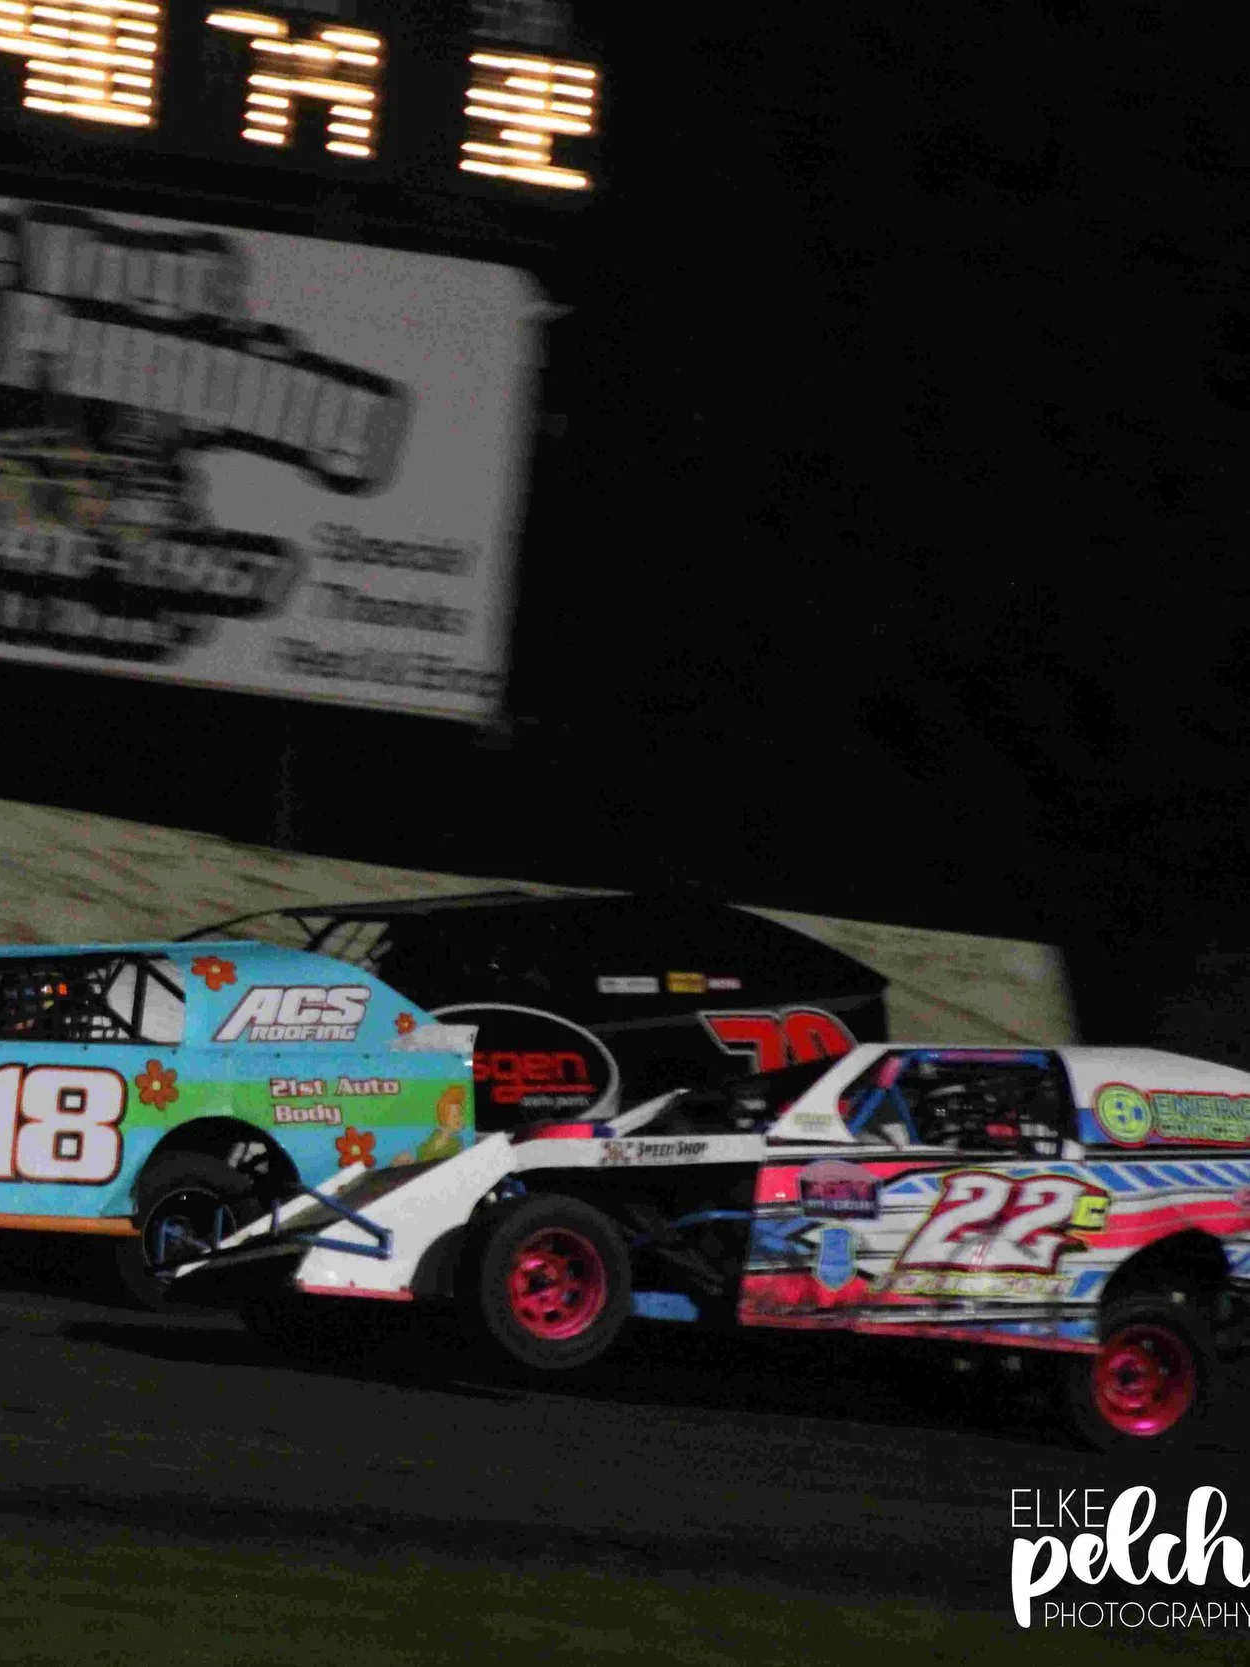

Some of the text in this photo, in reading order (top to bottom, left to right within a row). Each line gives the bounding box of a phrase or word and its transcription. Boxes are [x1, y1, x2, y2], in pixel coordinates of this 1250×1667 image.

[213, 985, 372, 1042] ACS
[269, 1077, 402, 1099] 21st Auto
[473, 1050, 592, 1105] sgen
[272, 1103, 343, 1126] Body
[895, 1168, 1095, 1273] 22
